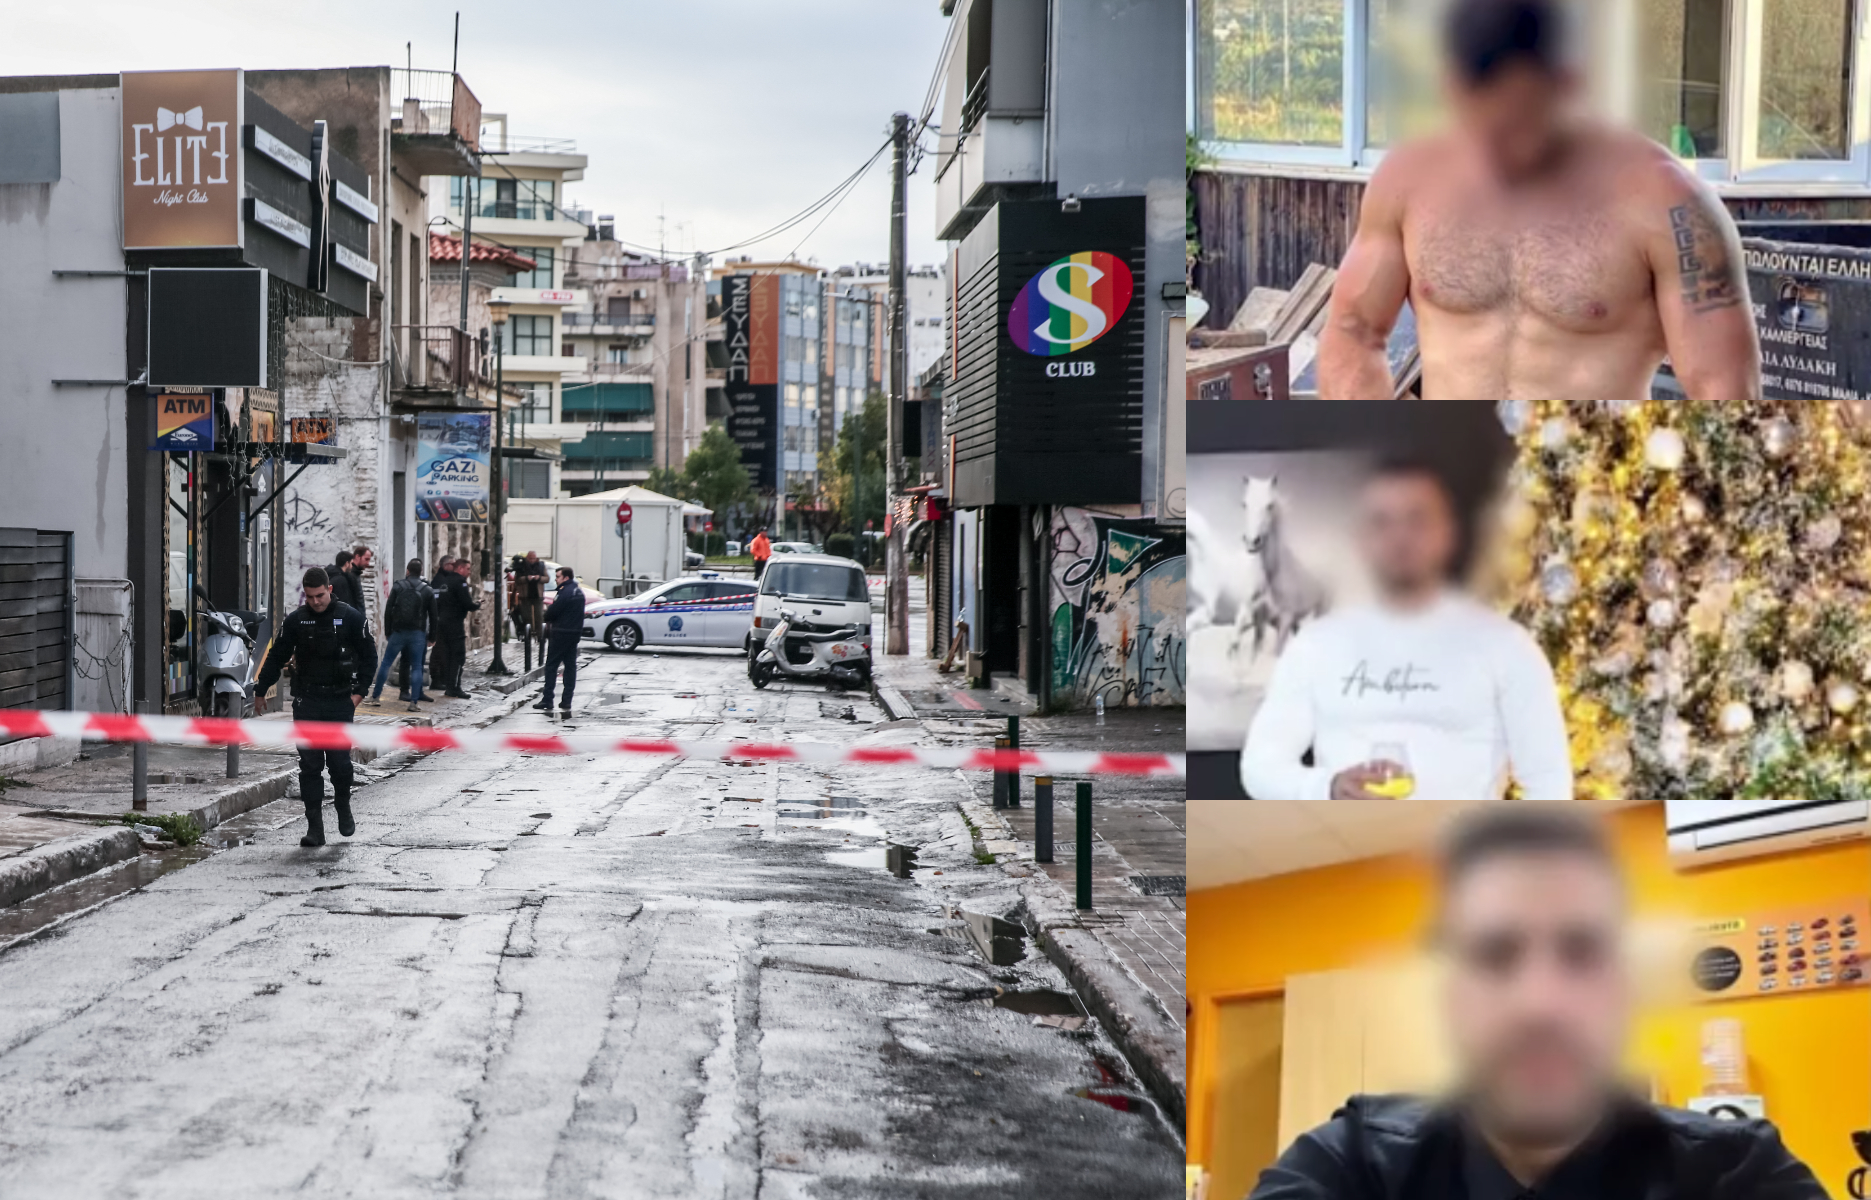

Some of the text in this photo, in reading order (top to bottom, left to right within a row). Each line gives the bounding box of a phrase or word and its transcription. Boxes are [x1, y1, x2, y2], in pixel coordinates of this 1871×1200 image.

[132, 121, 229, 186] ELITE
[153, 189, 209, 207] Night Club
[1033, 262, 1106, 344] S
[1045, 361, 1096, 378] CLUB
[164, 399, 205, 413] ATM
[297, 421, 328, 434] ATM
[1340, 659, 1440, 702] Ambition
